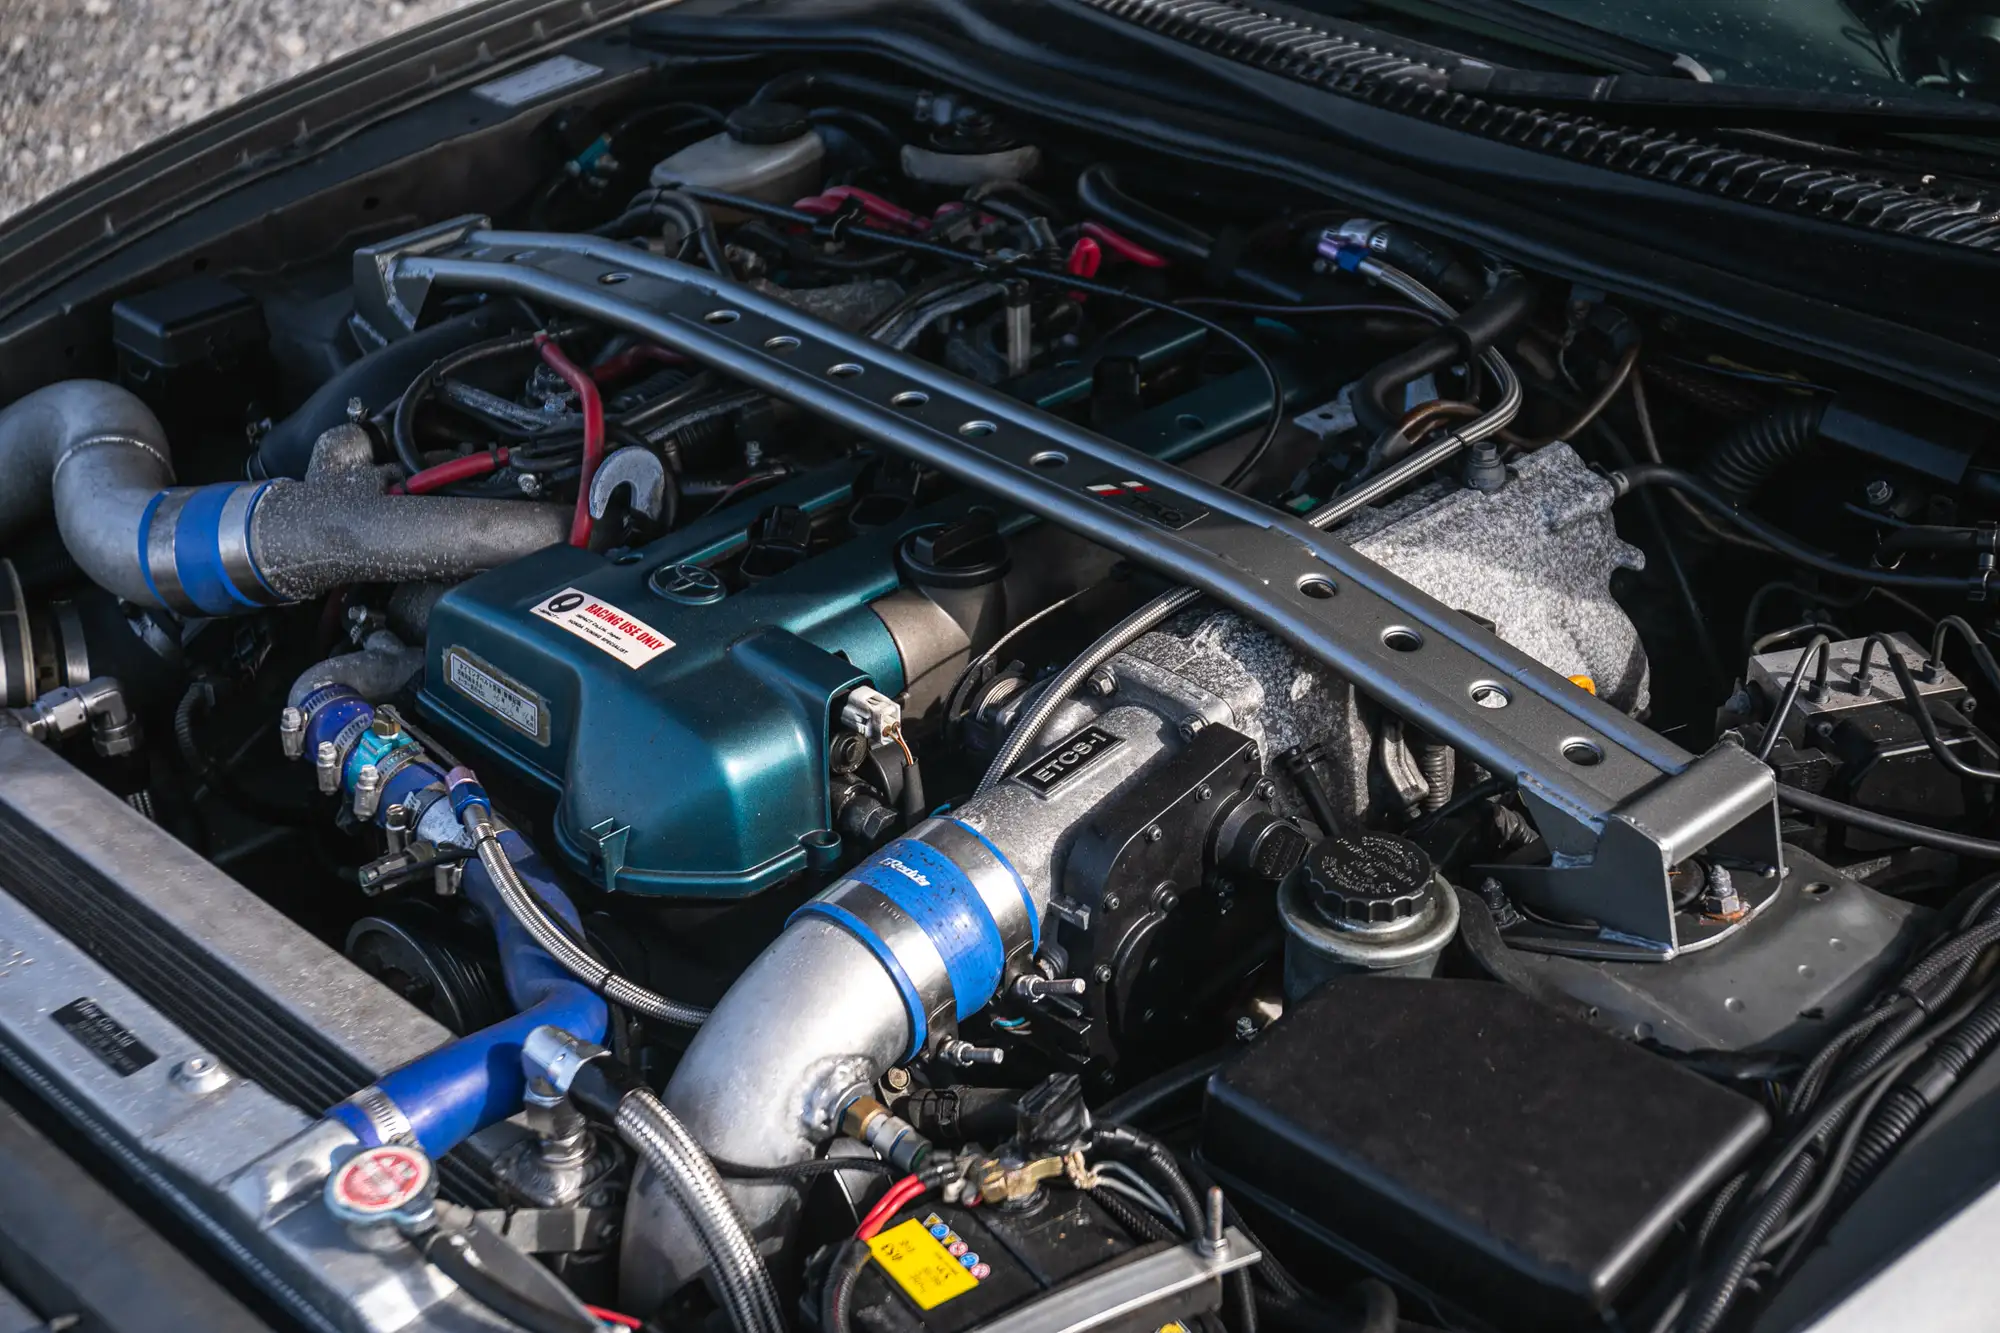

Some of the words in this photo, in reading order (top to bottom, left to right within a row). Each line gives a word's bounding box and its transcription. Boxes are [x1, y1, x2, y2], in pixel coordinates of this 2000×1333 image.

[585, 603, 621, 626] RACING
[619, 620, 641, 636] USE
[636, 631, 665, 650] ONLY
